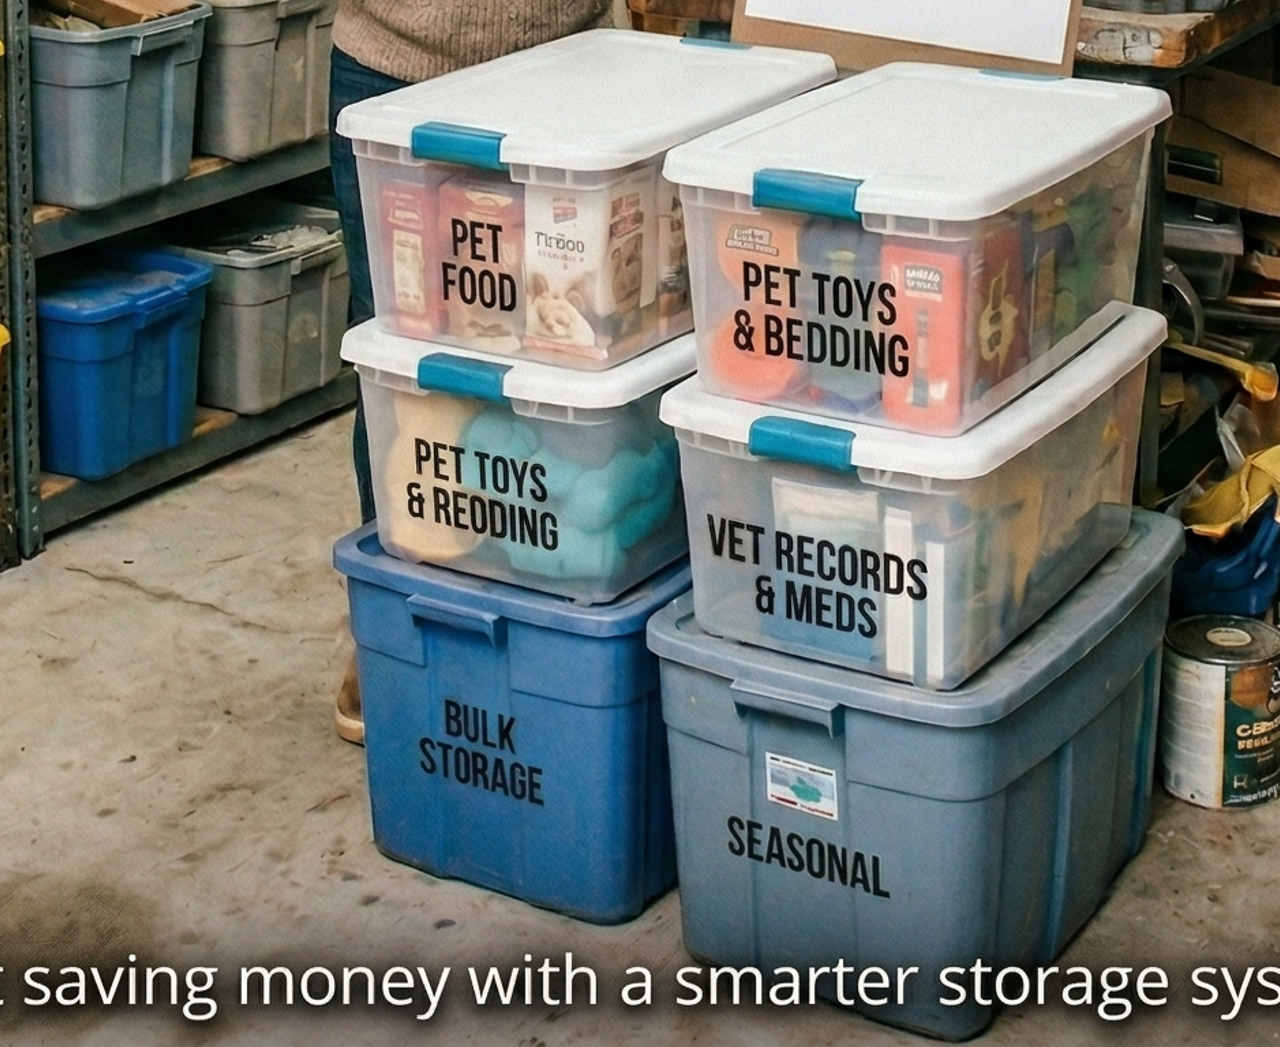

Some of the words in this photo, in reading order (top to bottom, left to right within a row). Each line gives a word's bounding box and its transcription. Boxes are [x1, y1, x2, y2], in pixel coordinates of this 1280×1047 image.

[451, 218, 503, 264] PET
[442, 261, 517, 312] FOOD
[742, 261, 801, 308] PET
[812, 272, 897, 326] TOYS
[733, 308, 755, 352] &
[764, 313, 910, 378] BEDDING
[406, 482, 425, 519] &
[414, 437, 465, 485] PET
[474, 450, 547, 502] TOYS
[706, 513, 765, 565] VET
[775, 530, 928, 601] RECORDS
[755, 575, 775, 614] &
[785, 580, 878, 639] MEDS
[444, 698, 516, 754] BULK
[419, 738, 544, 806] STORAGE
[726, 816, 890, 899] SEASONAL
